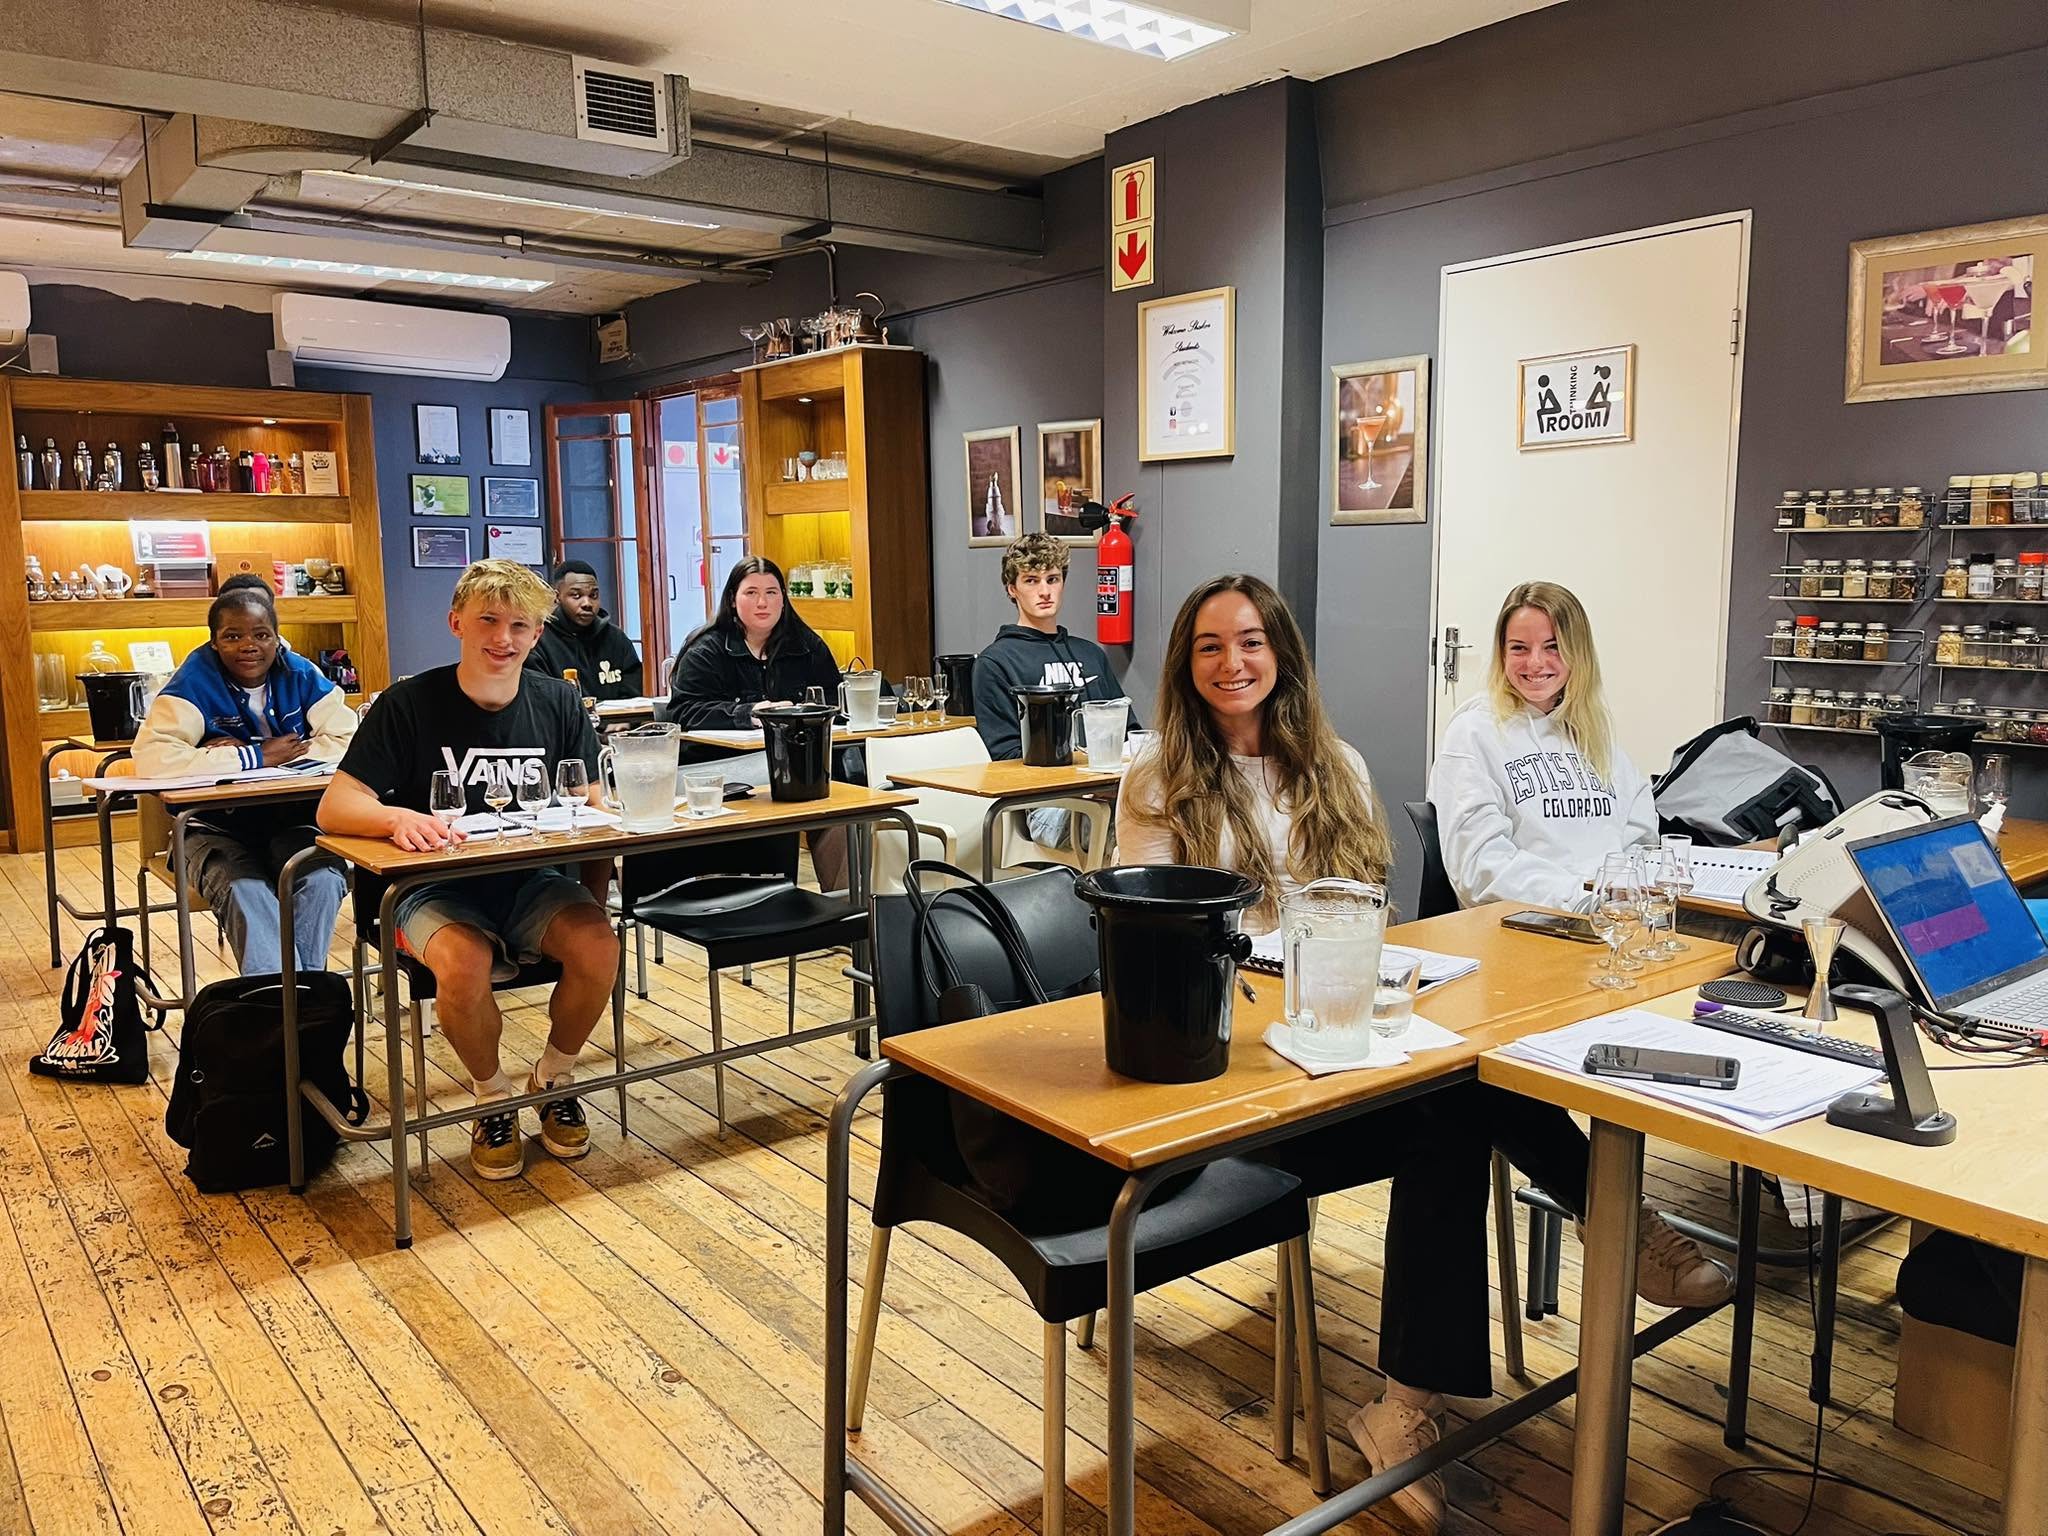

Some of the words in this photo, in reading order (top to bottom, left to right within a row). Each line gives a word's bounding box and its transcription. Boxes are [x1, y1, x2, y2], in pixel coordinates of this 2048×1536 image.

[1546, 411, 1601, 432] ROOM
[441, 746, 546, 787] VANS
[1543, 797, 1612, 818] COLORADO
